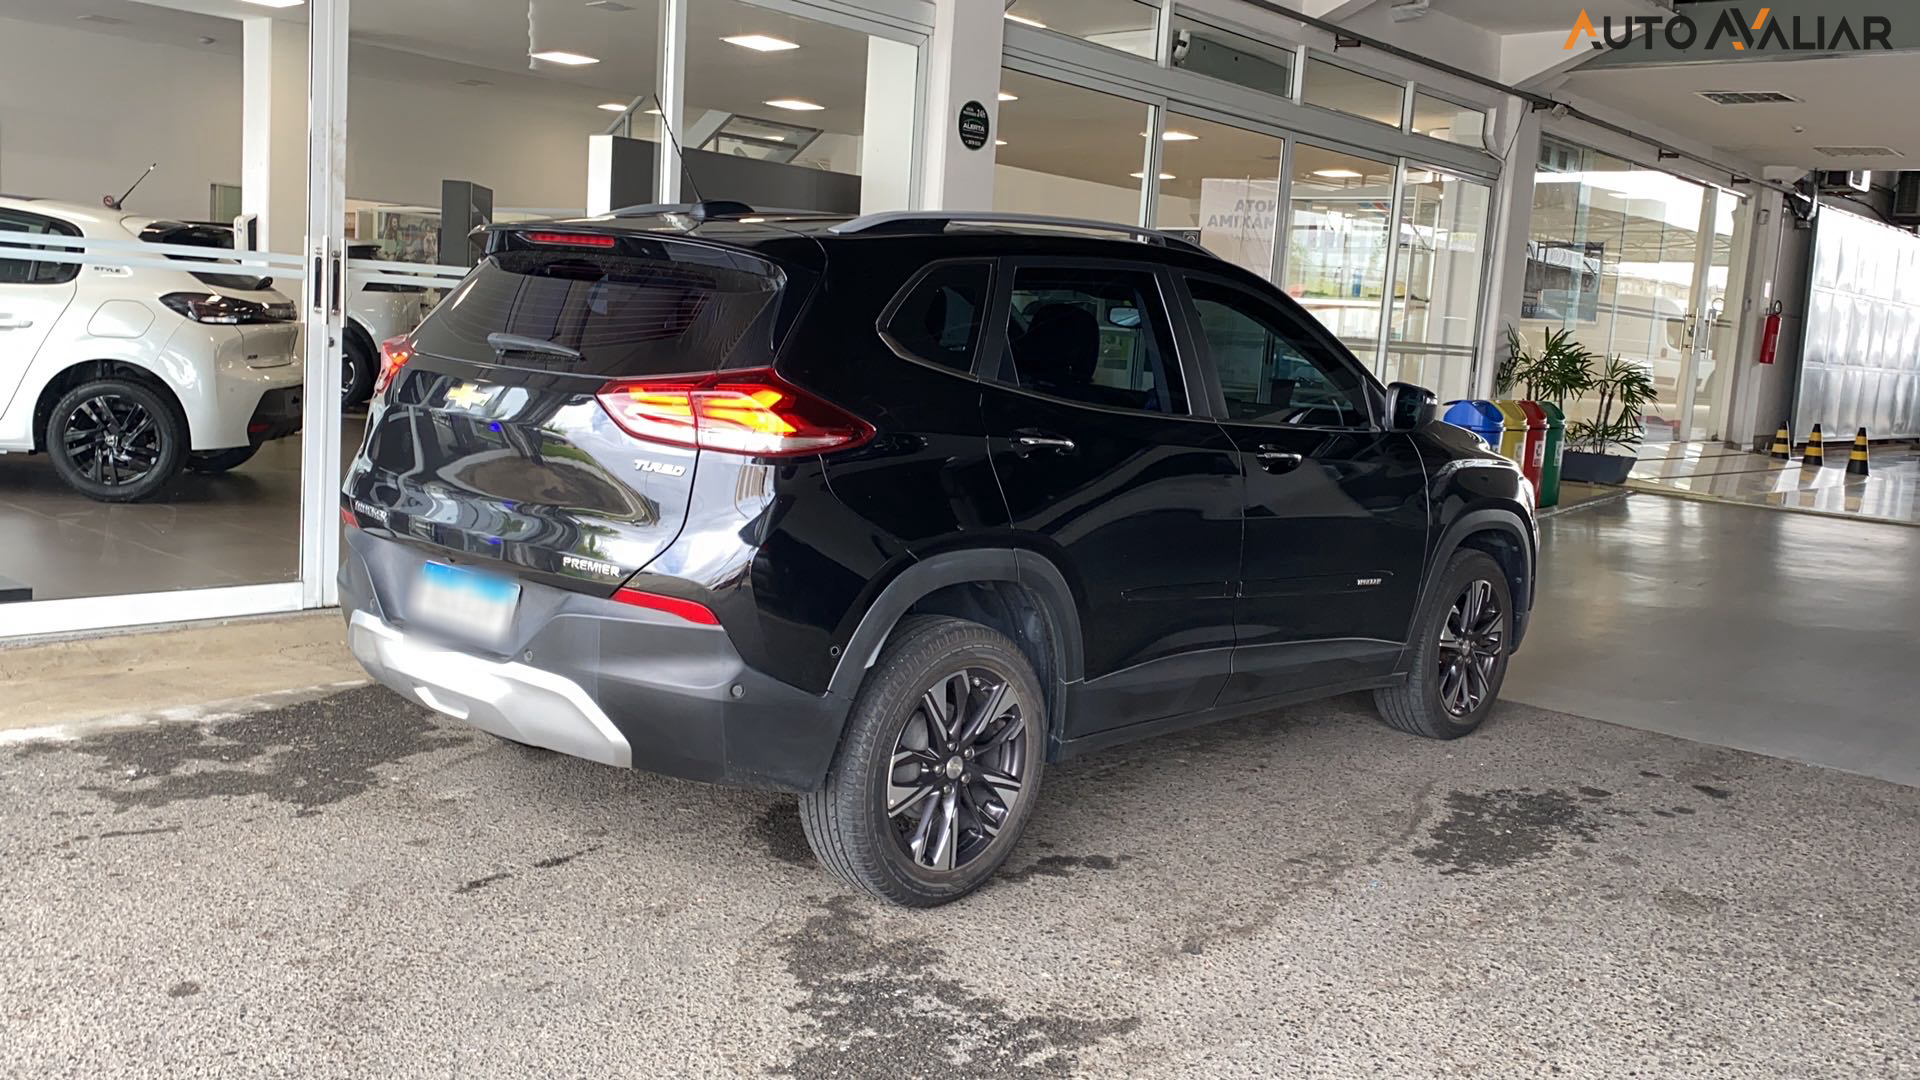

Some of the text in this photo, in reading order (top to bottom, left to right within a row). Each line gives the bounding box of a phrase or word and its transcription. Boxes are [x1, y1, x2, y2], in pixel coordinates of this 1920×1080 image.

[963, 122, 985, 132] ALERTA
[94, 265, 119, 273] STYLE
[634, 458, 687, 478] TURBO
[563, 556, 620, 577] PREMIER
